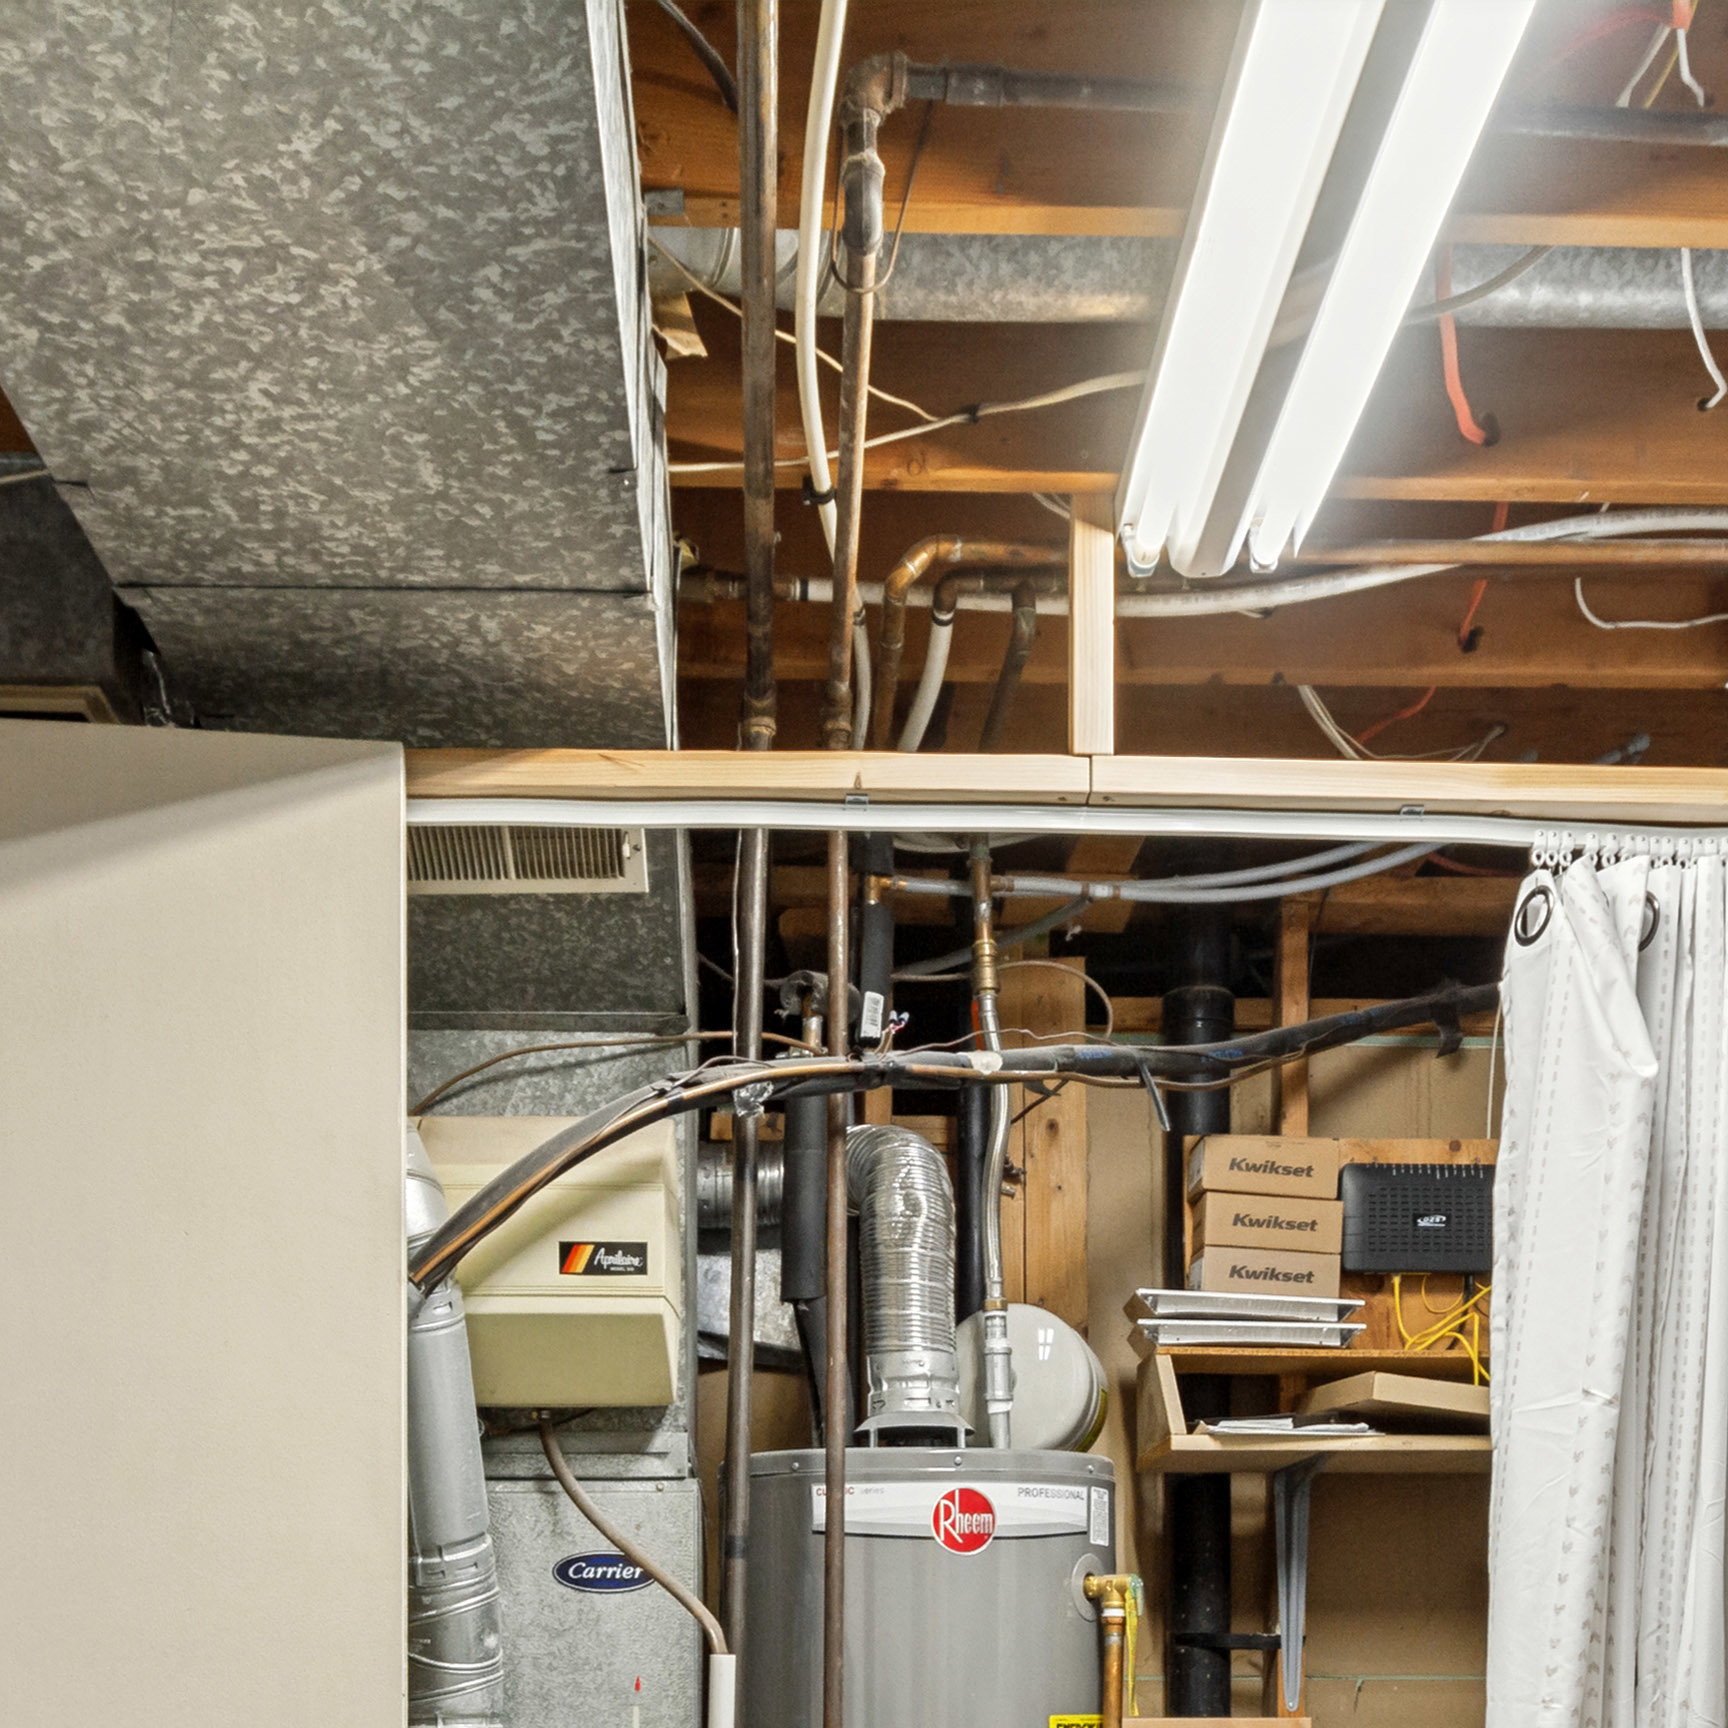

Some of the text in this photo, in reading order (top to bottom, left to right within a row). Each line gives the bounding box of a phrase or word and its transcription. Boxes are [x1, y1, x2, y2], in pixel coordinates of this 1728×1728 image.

[1229, 1157, 1314, 1178] Kwikset
[1233, 1213, 1318, 1232] Kwikset
[1229, 1265, 1314, 1284] Kwikset
[1017, 1487, 1085, 1501] PROFESSIONAL
[938, 1489, 994, 1544] Rheem
[568, 1561, 644, 1579] Carrier
